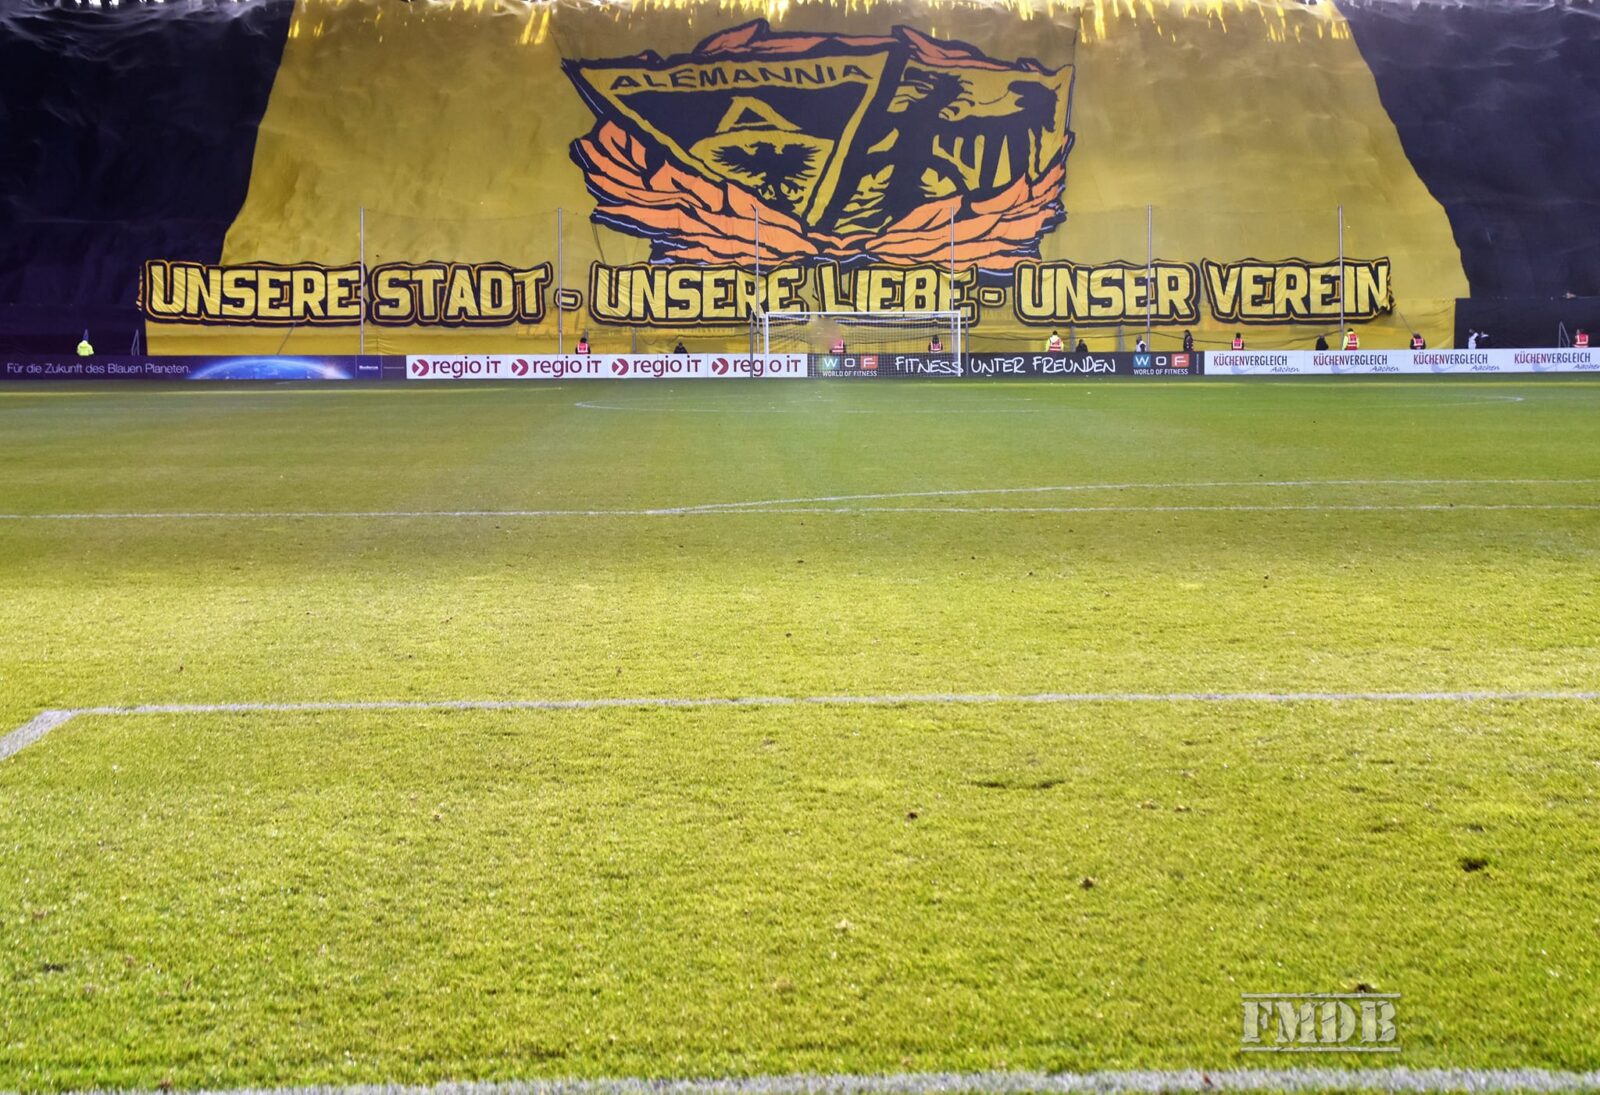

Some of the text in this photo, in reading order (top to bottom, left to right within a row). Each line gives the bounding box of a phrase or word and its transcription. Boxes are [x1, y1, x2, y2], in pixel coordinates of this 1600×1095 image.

[610, 63, 873, 91] ALEMANNIA
[147, 262, 364, 321] UNSERE
[372, 262, 551, 321] STADT
[593, 263, 804, 322] UNSERE
[818, 262, 976, 321] LIEBE
[1017, 261, 1198, 322] UNSER
[1204, 258, 1391, 321] VEREIN
[633, 355, 682, 377] regio
[895, 356, 1116, 374] FITNESS UNTER FREUNDEN
[1213, 354, 1288, 366] KÜCHENVERGLEICH
[1313, 353, 1388, 366] KÜCHENVERGLEICH
[1413, 352, 1488, 365] KÜCHENVERGLEICH
[1514, 351, 1591, 364] KÜCHENVERGLEICH
[7, 362, 192, 374] Für die Zukunft des Blauen Planeten.
[433, 356, 481, 378] regio
[533, 356, 582, 378] regio
[733, 358, 782, 377] rego
